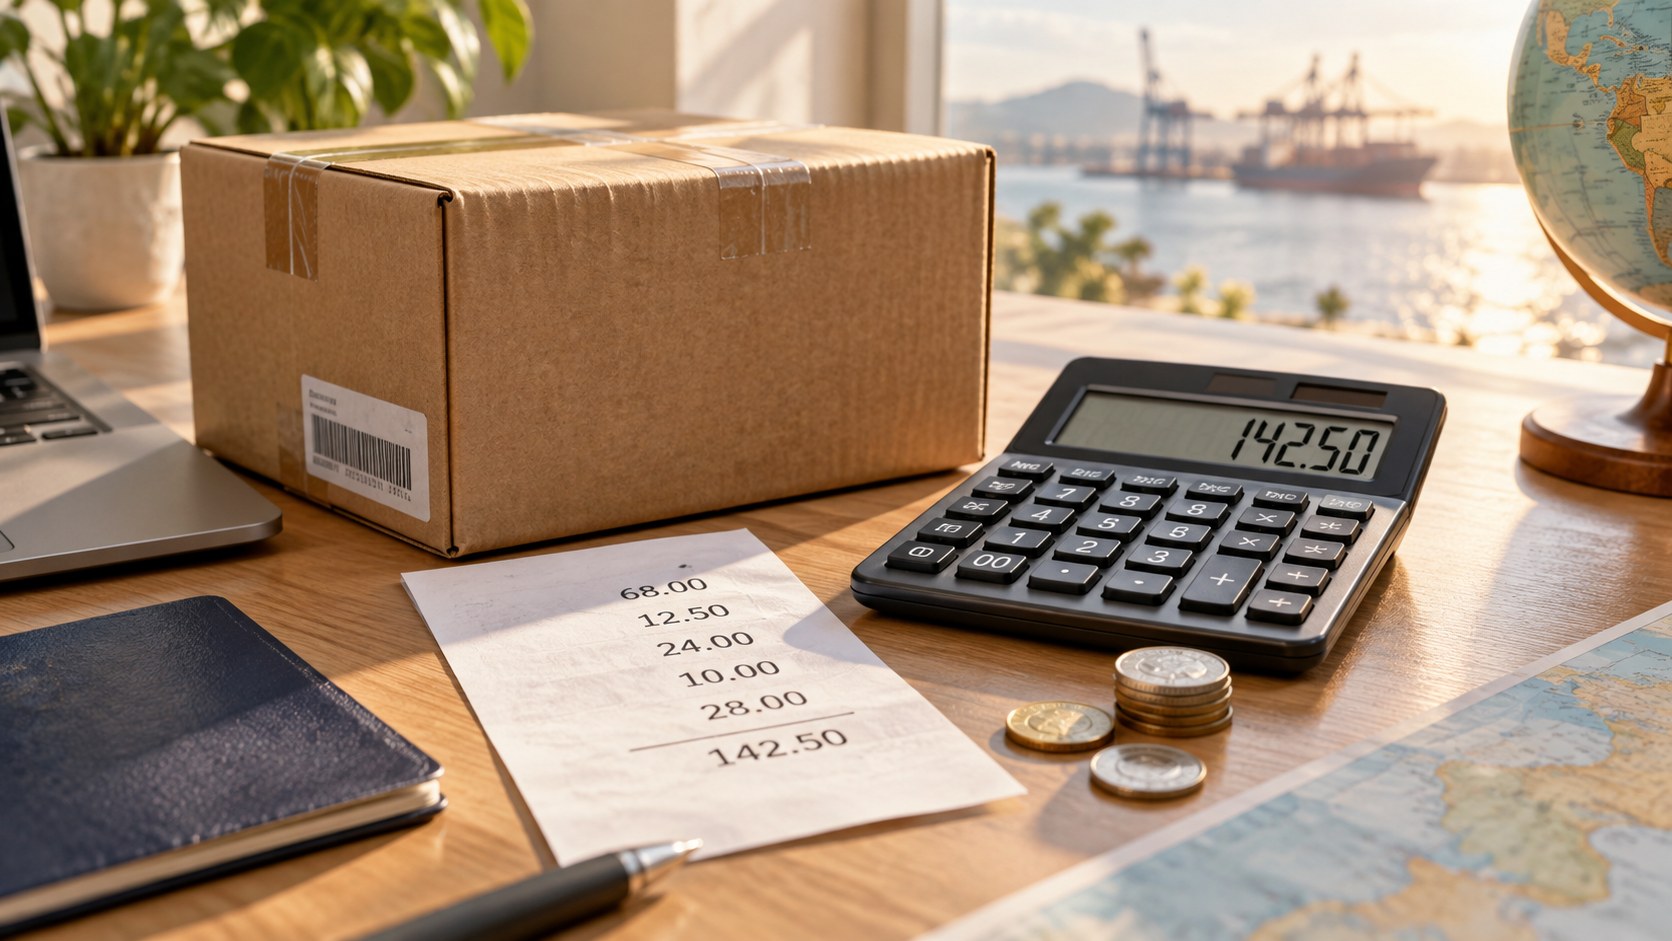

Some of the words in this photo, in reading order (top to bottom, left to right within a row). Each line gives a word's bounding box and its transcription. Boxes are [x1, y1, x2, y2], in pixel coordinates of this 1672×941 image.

[1231, 418, 1380, 475] 142.50
[1056, 488, 1077, 499] 7
[1120, 496, 1140, 507] 8
[1031, 509, 1052, 521] 4
[1187, 504, 1207, 515] 8
[1098, 518, 1120, 529] 5
[1011, 532, 1026, 544] 1
[1075, 541, 1098, 553] 2
[973, 554, 1012, 569] 00
[1147, 551, 1170, 563] 3
[620, 578, 708, 600] 68.00
[638, 604, 730, 628] 12.50
[657, 632, 754, 657] 24.00
[679, 660, 780, 688] 10.00
[700, 691, 808, 720] 28.00
[708, 729, 848, 767] 142.50
